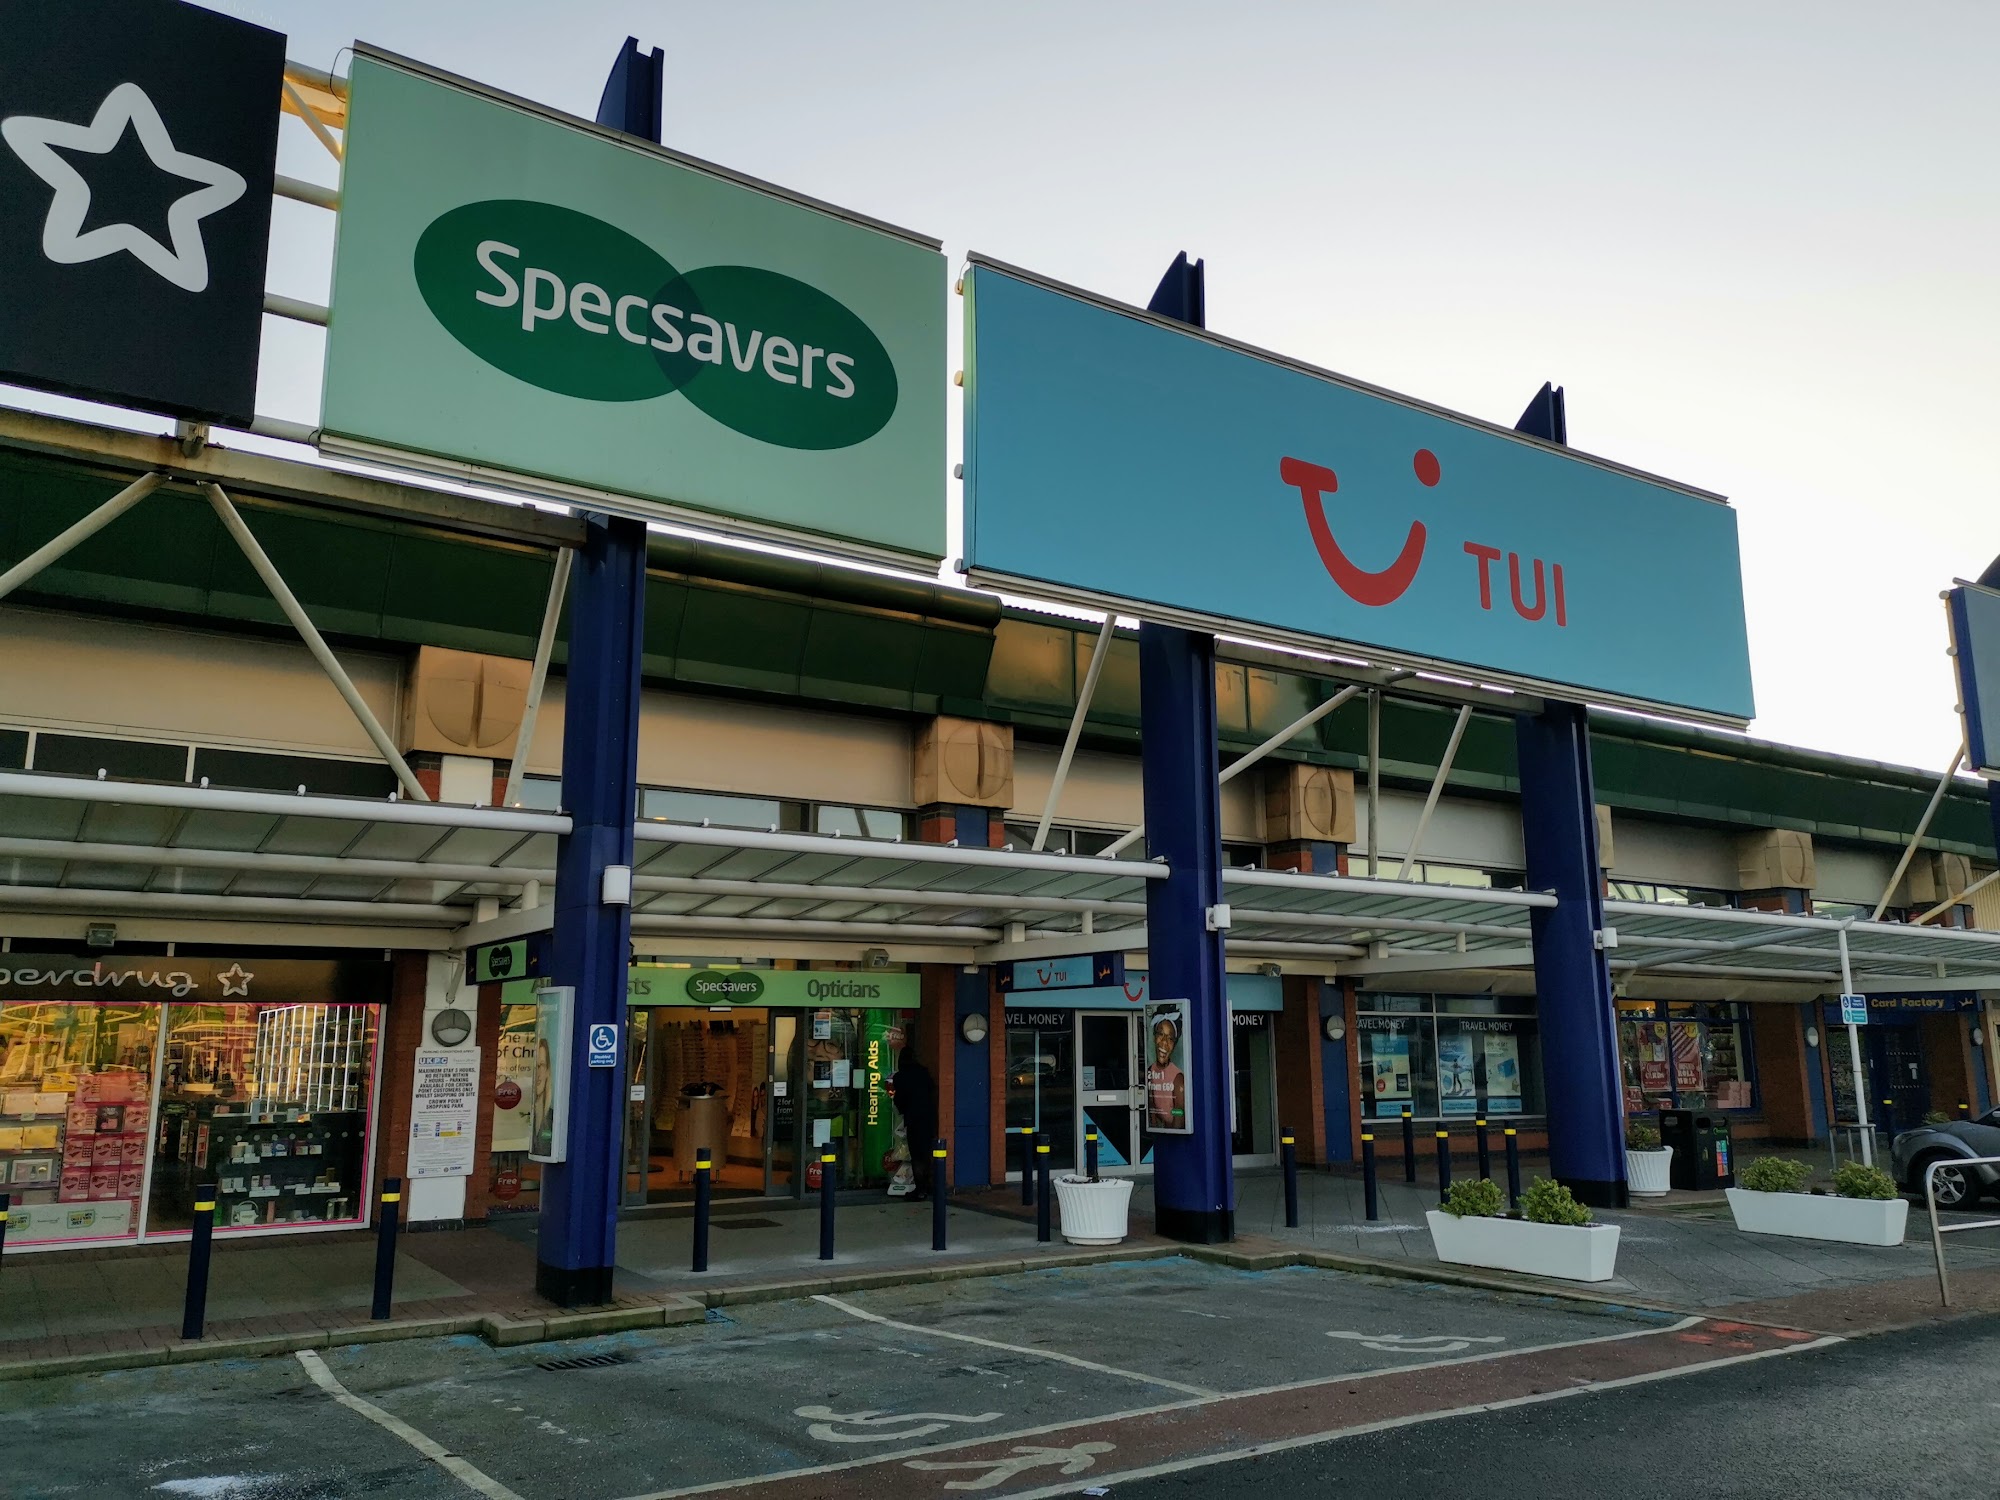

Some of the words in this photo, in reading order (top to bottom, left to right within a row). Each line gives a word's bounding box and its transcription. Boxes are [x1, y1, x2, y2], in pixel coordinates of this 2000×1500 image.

[476, 240, 856, 398] Specsavers
[1464, 540, 1567, 626] TUI
[1054, 972, 1066, 982] TUI
[696, 980, 757, 994] Specsavers
[807, 978, 880, 1001] Opticians
[1871, 998, 1896, 1008] Card
[1902, 998, 1944, 1008] Factory
[1028, 1014, 1065, 1024] MONEY
[1232, 1014, 1264, 1026] MONEY
[1378, 1020, 1406, 1030] MONEY
[1460, 1020, 1487, 1030] TRAVEL
[1488, 1022, 1512, 1031] MONEY
[868, 1040, 879, 1070] Aids
[1148, 1071, 1152, 1079] 2
[1152, 1071, 1160, 1079] for
[1162, 1071, 1164, 1080] 1
[1148, 1082, 1161, 1090] from
[1162, 1082, 1174, 1091] £69
[868, 1072, 881, 1126] Hearing
